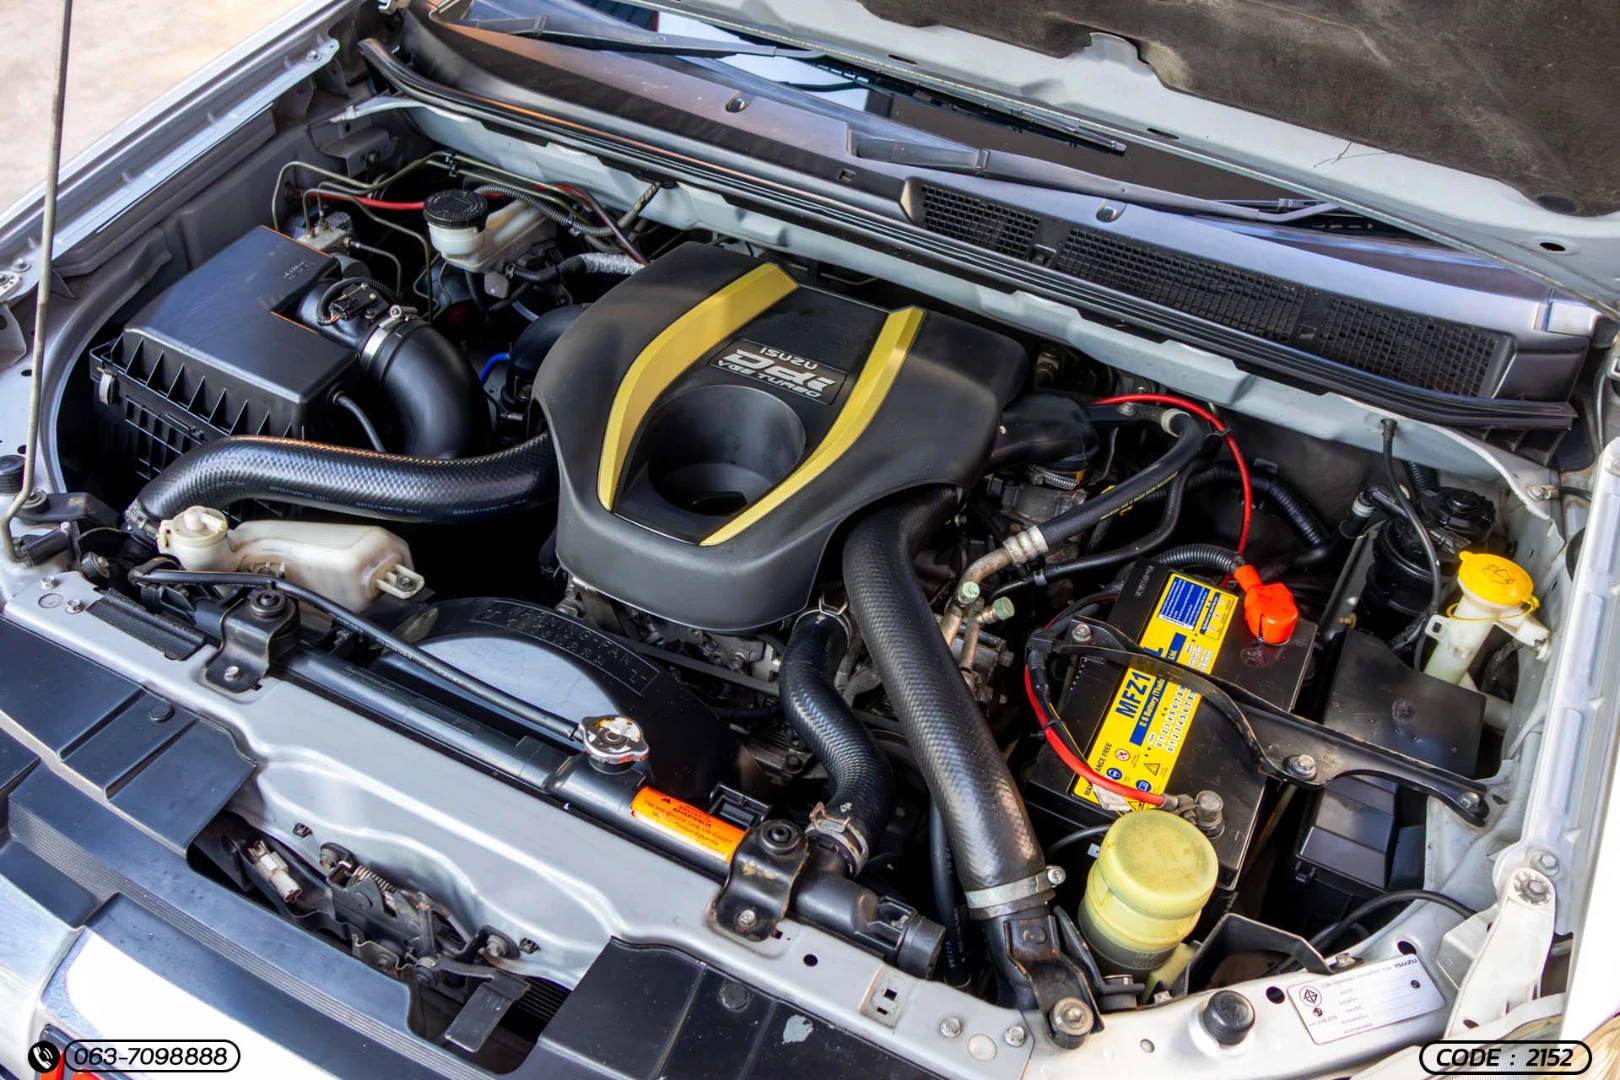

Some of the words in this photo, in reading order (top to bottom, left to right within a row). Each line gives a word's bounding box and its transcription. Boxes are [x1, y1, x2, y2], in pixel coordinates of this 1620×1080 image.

[760, 347, 818, 371] ISUZU
[758, 372, 822, 398] TURBO
[1144, 696, 1159, 716] Battery
[1104, 742, 1112, 757] FREE
[1394, 958, 1418, 969] ISUZU
